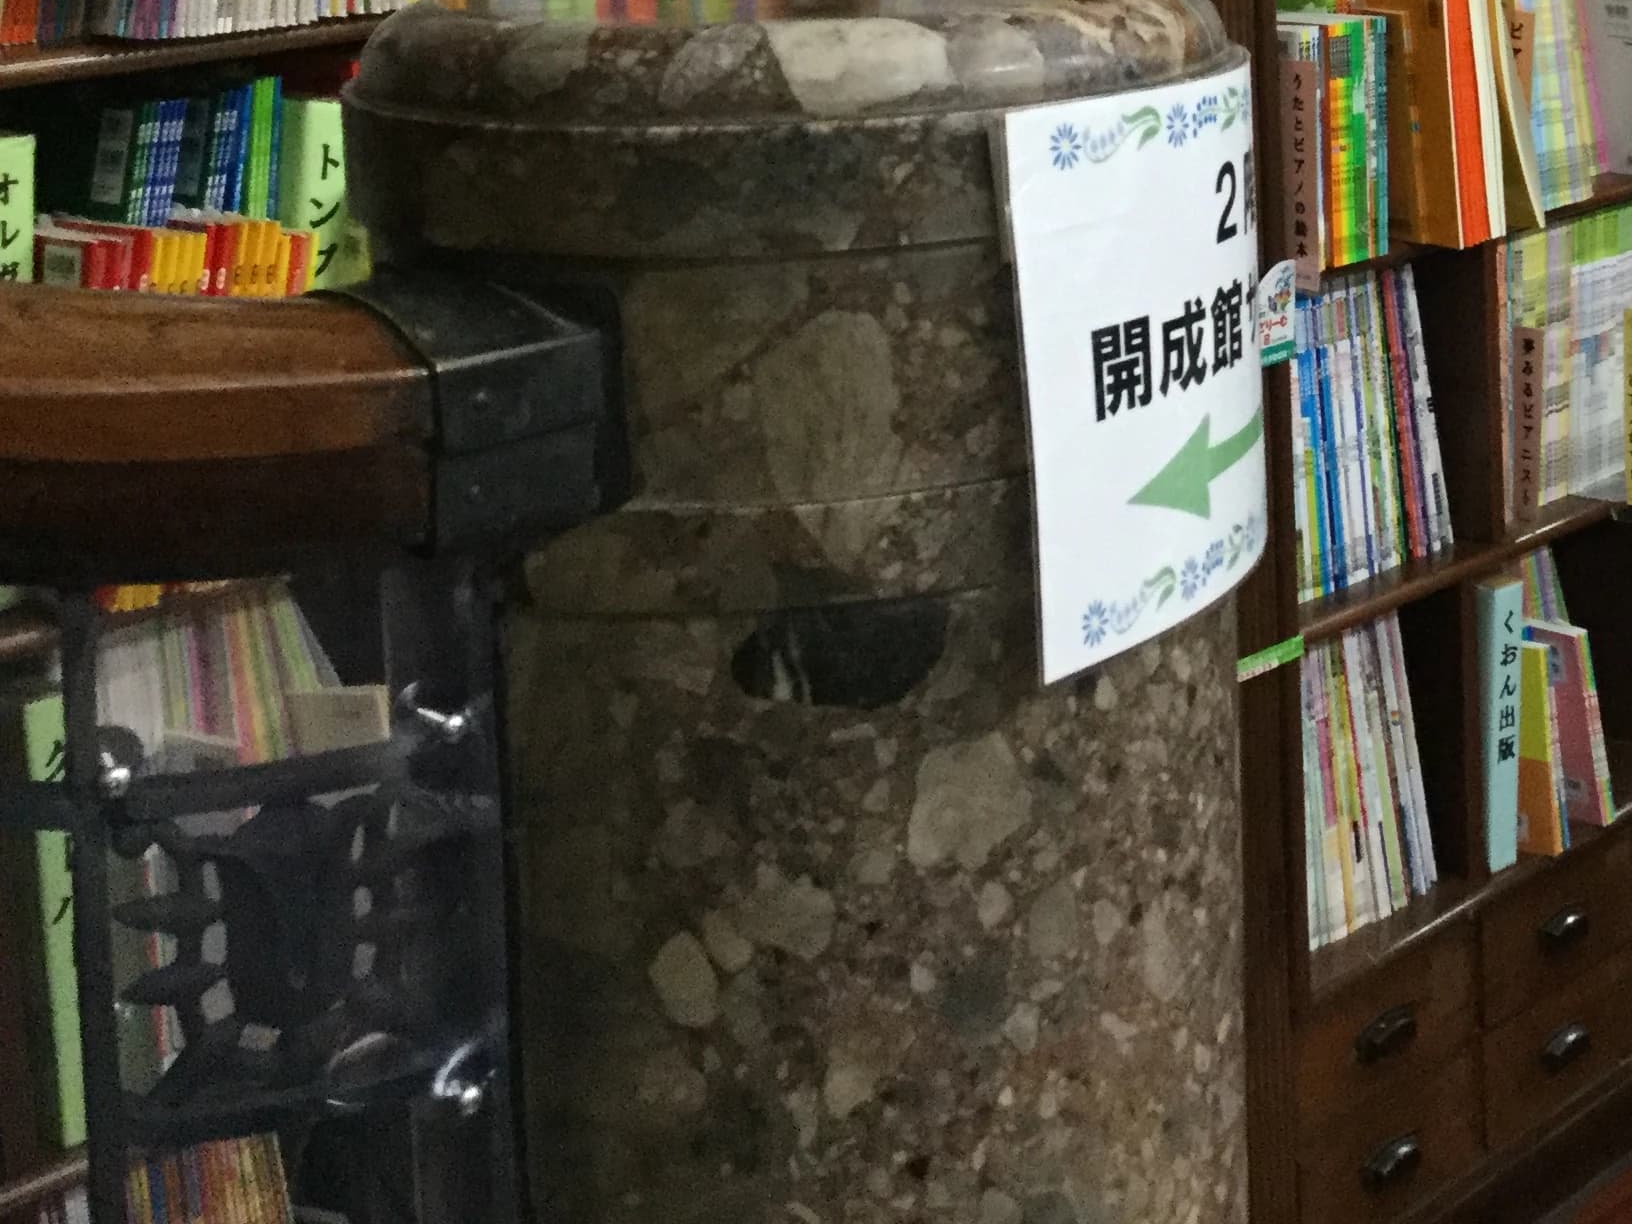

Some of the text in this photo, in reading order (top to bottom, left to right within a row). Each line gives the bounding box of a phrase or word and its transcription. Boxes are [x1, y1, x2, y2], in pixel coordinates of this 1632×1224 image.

[1521, 337, 1536, 507] 夢みるピアニスト
[1497, 609, 1518, 765] くおん出版
